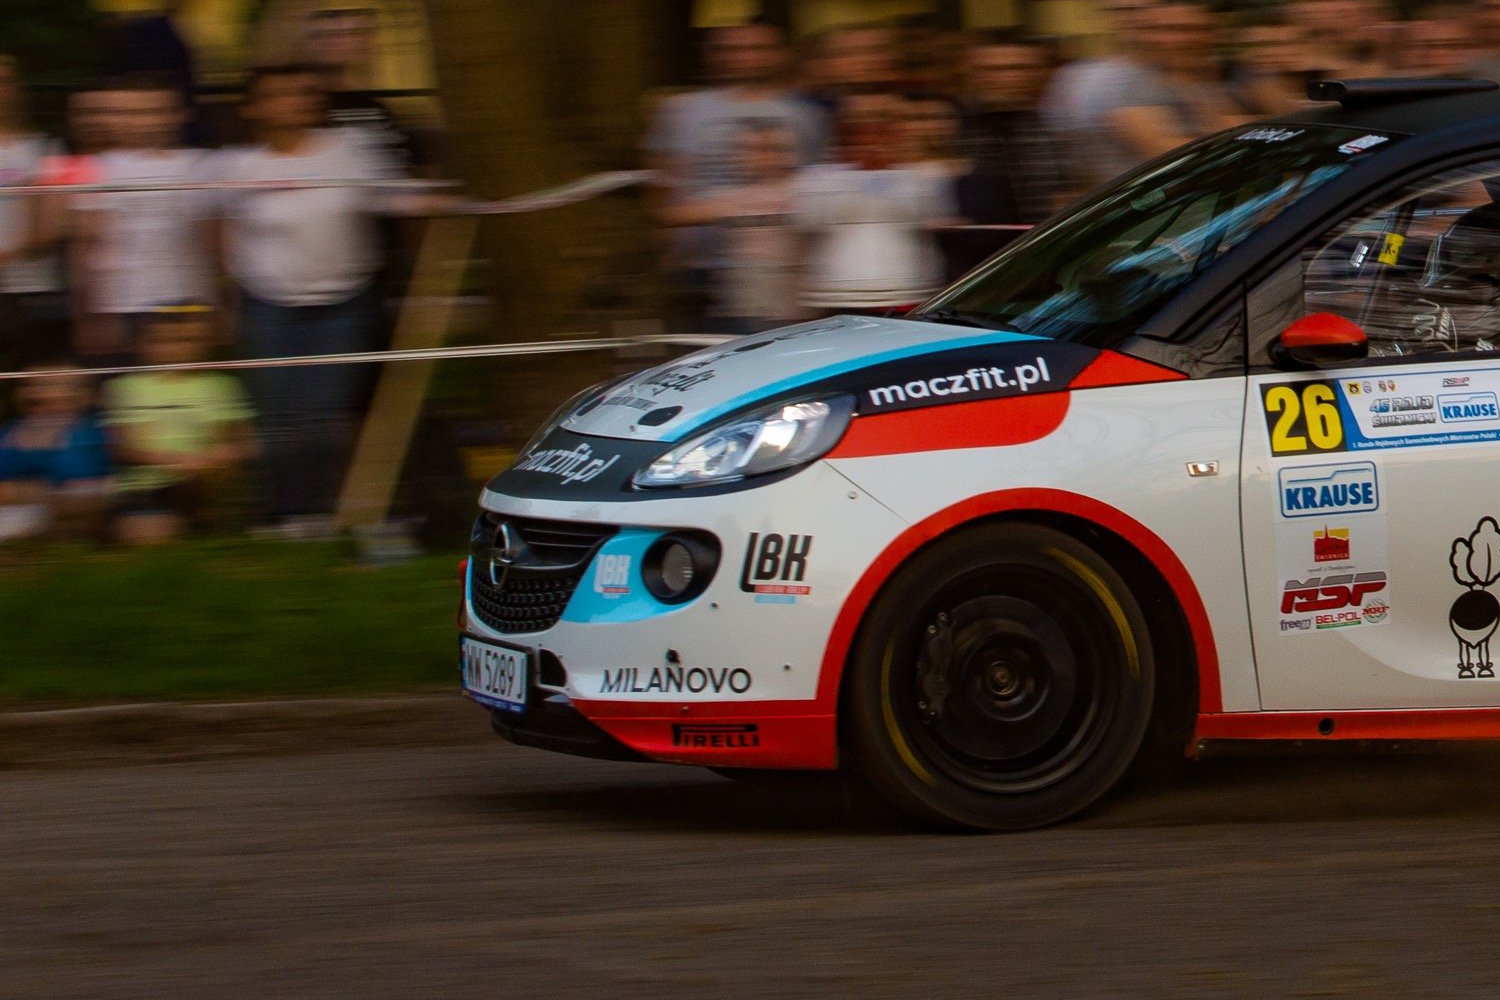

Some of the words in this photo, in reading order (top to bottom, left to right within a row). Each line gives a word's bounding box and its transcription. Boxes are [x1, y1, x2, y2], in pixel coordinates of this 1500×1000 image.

[868, 356, 1051, 407] maczfit.pl
[1265, 383, 1343, 453] 26
[1443, 404, 1497, 419] KRAUSE
[1286, 482, 1374, 511] KRAUSE
[740, 532, 814, 593] LBK
[600, 667, 751, 694] MILANOVO
[672, 723, 760, 747] PIRELLI
